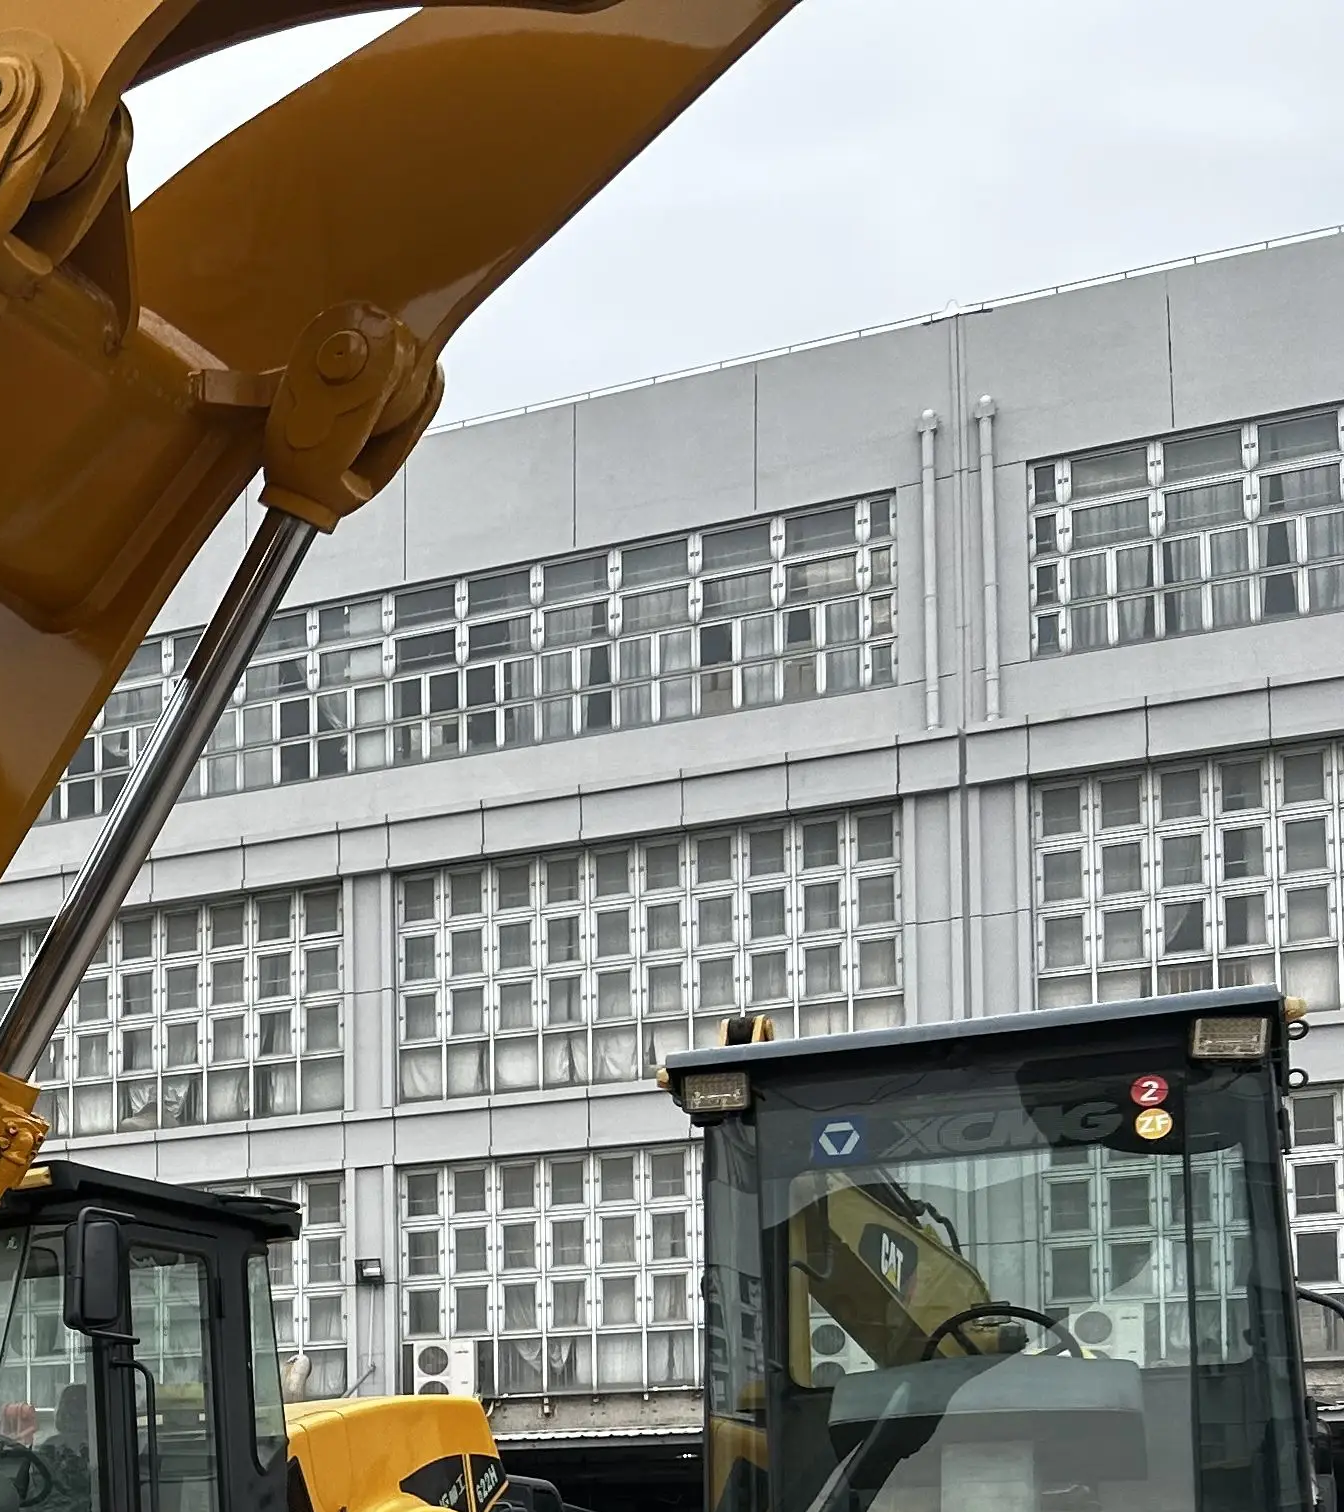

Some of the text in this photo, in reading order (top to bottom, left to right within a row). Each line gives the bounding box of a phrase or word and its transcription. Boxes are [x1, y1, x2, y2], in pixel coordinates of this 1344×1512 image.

[1140, 1080, 1159, 1102] 2
[882, 1101, 1123, 1157] XCMG
[1140, 1113, 1170, 1134] ZF
[881, 1232, 904, 1292] CAT
